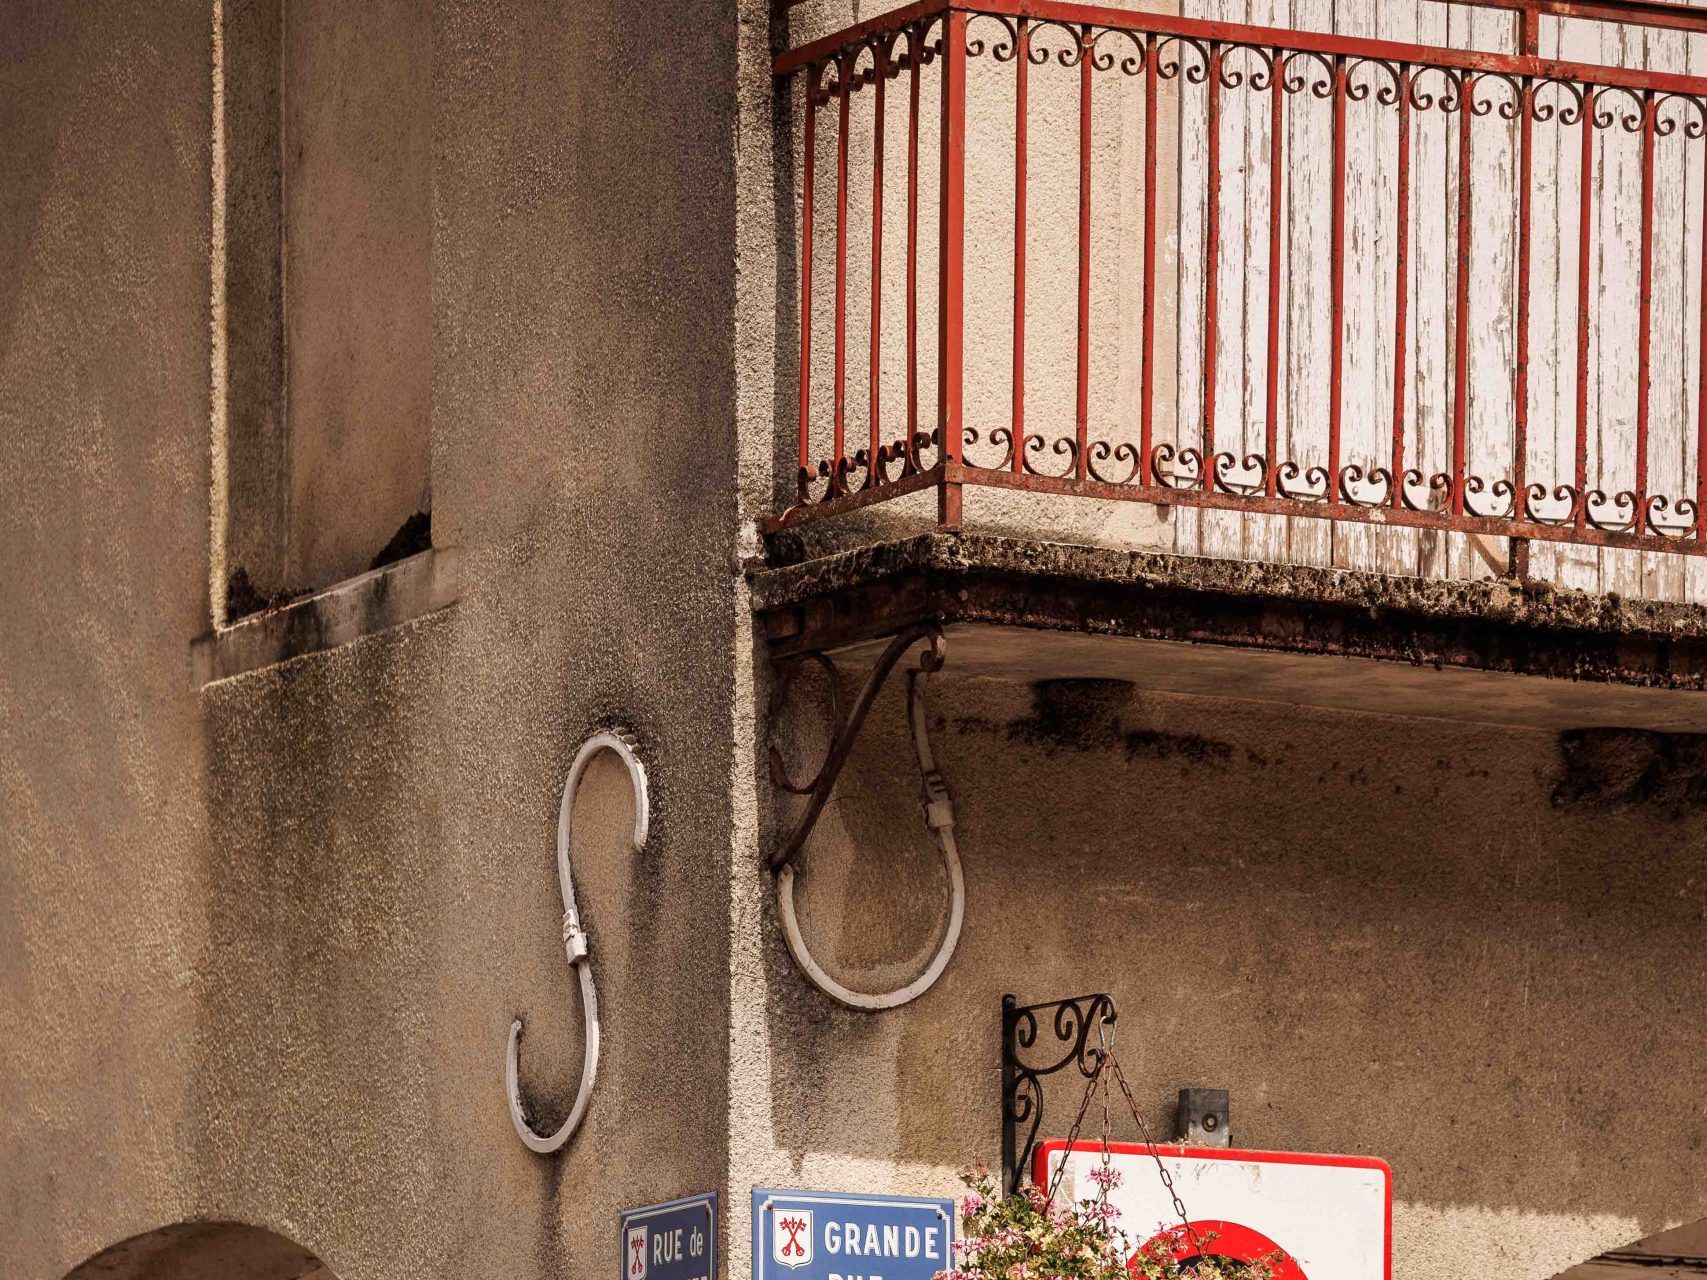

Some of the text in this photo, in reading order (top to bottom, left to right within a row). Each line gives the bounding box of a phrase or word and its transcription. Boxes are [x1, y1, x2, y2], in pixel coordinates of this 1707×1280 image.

[653, 1225, 704, 1266] RUE de
[824, 1221, 940, 1259] GRANDE
